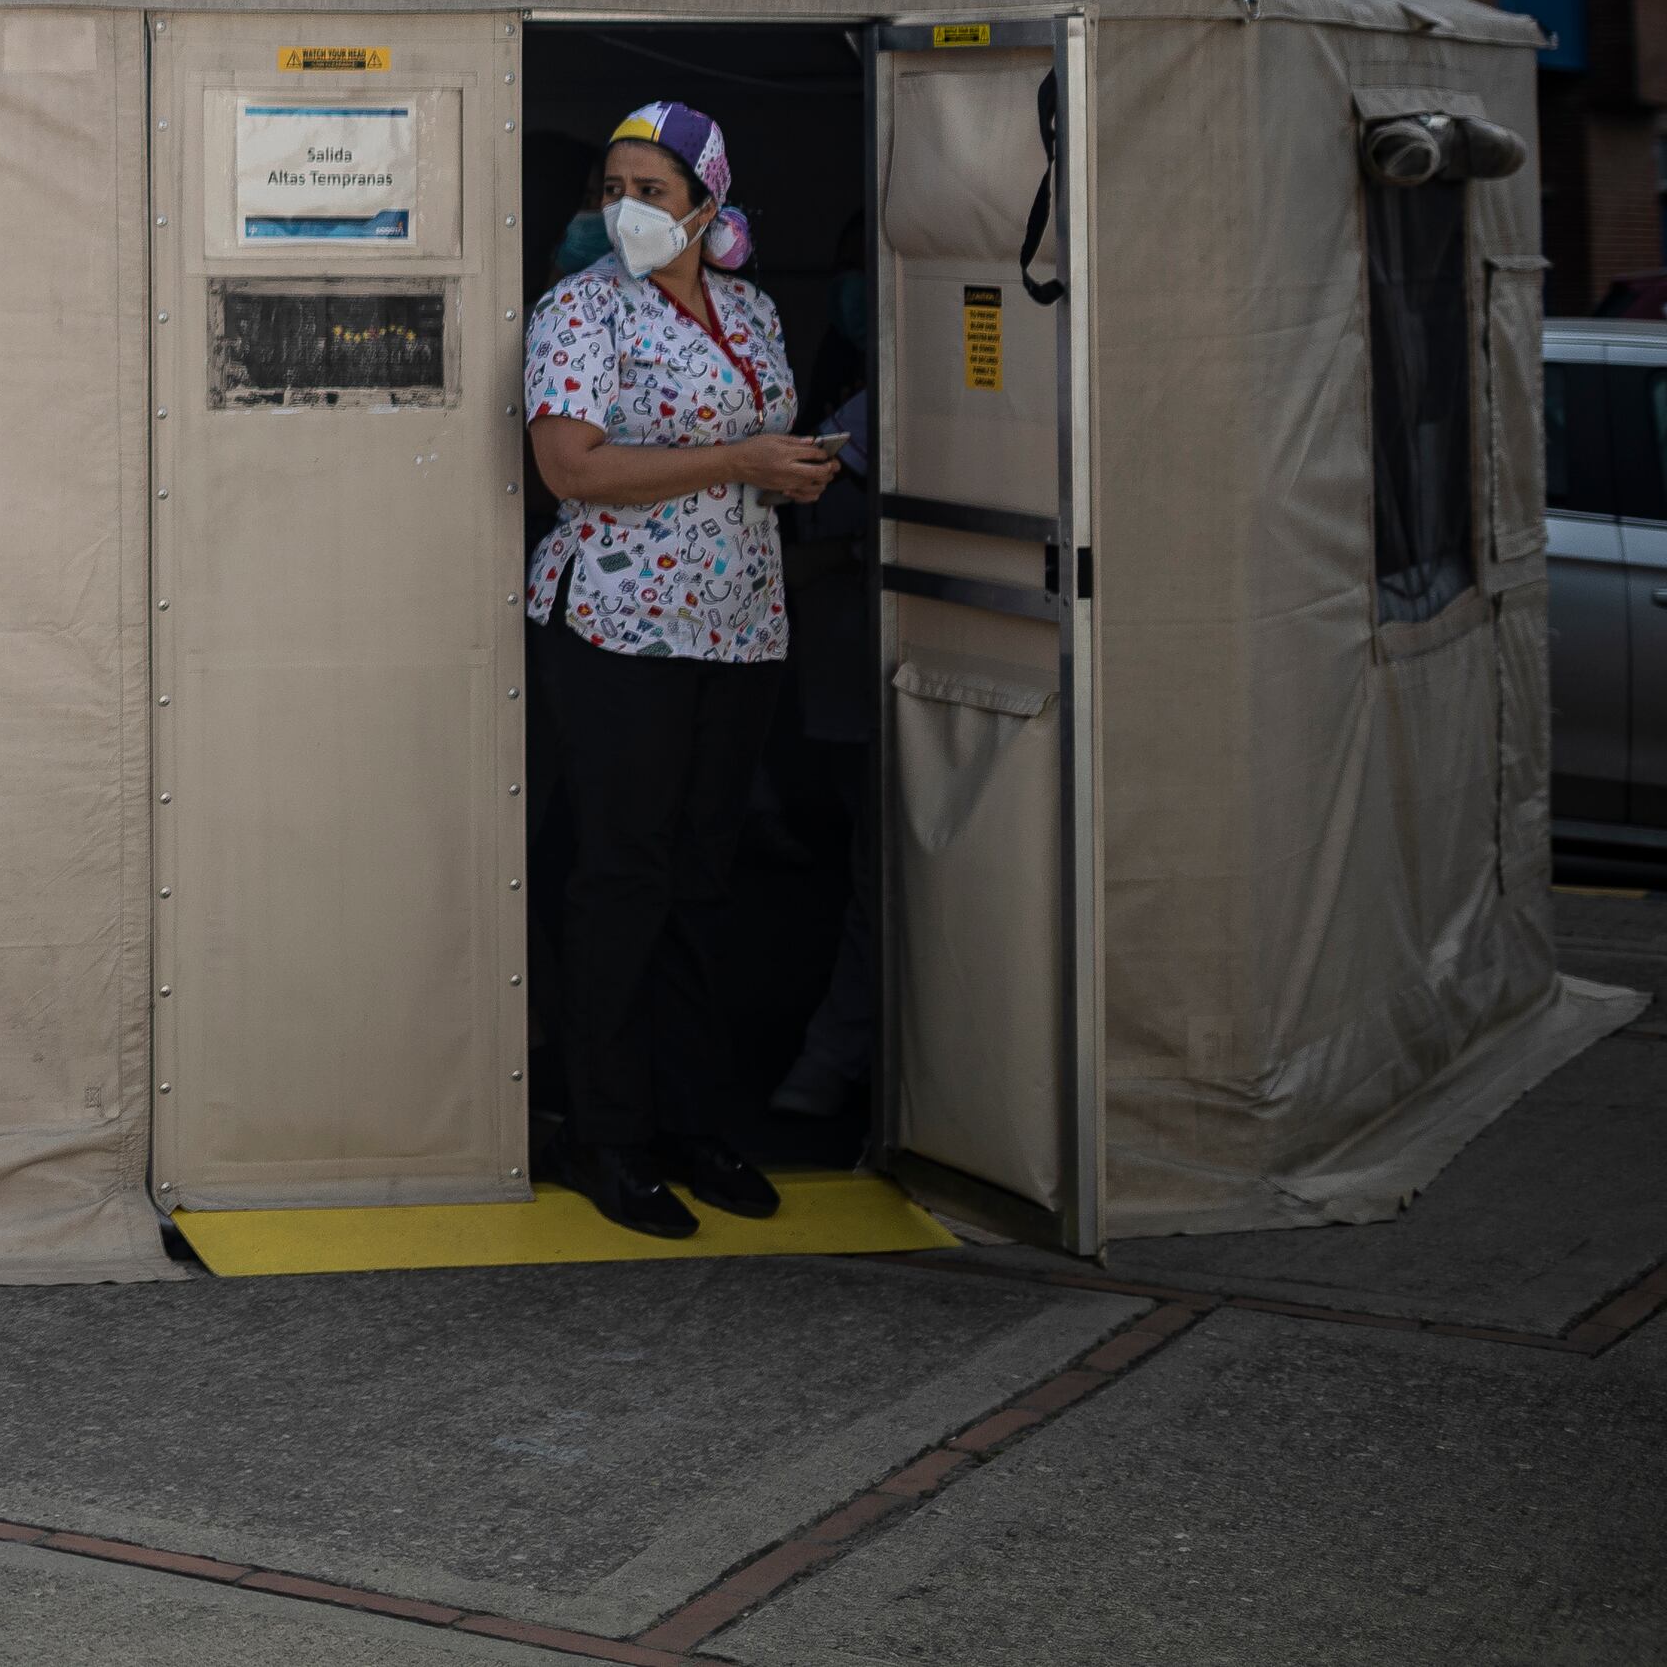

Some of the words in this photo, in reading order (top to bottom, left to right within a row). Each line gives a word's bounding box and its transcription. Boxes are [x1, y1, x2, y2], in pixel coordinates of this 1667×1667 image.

[307, 147, 352, 163] Salida
[268, 169, 306, 186] Altas
[310, 171, 393, 189] Tempranas
